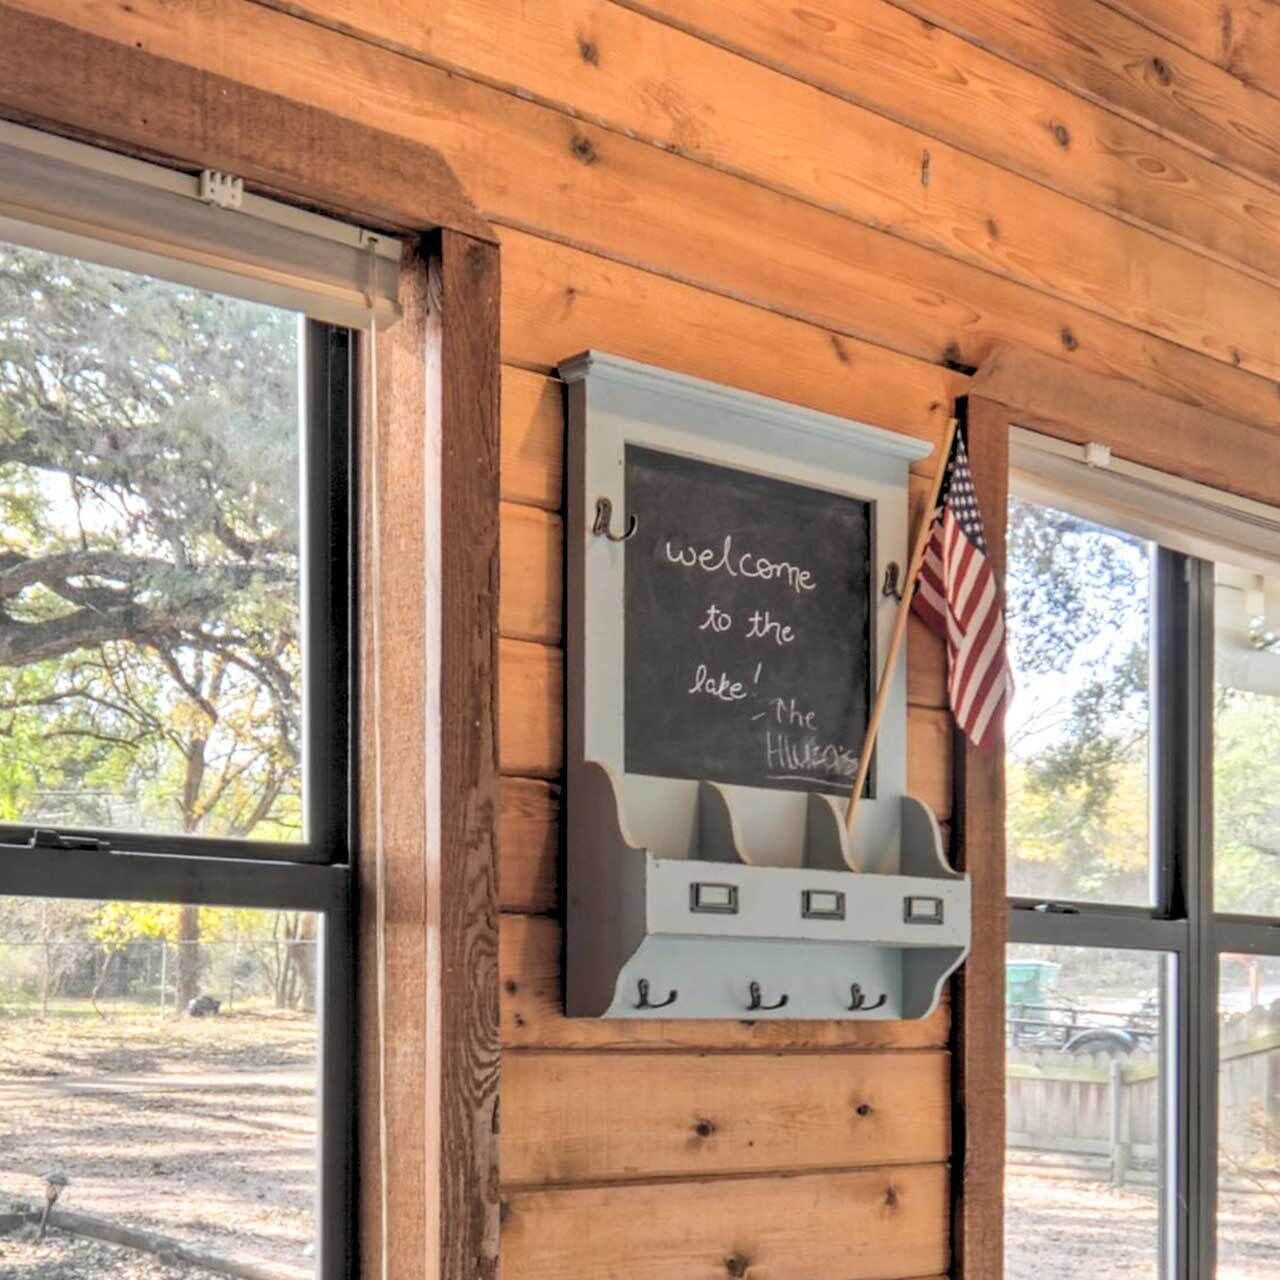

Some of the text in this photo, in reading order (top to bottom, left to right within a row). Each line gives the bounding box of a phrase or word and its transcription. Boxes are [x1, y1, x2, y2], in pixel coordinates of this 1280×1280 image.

[665, 534, 817, 594] welcome
[698, 603, 796, 646] to the
[687, 661, 763, 702] lake!
